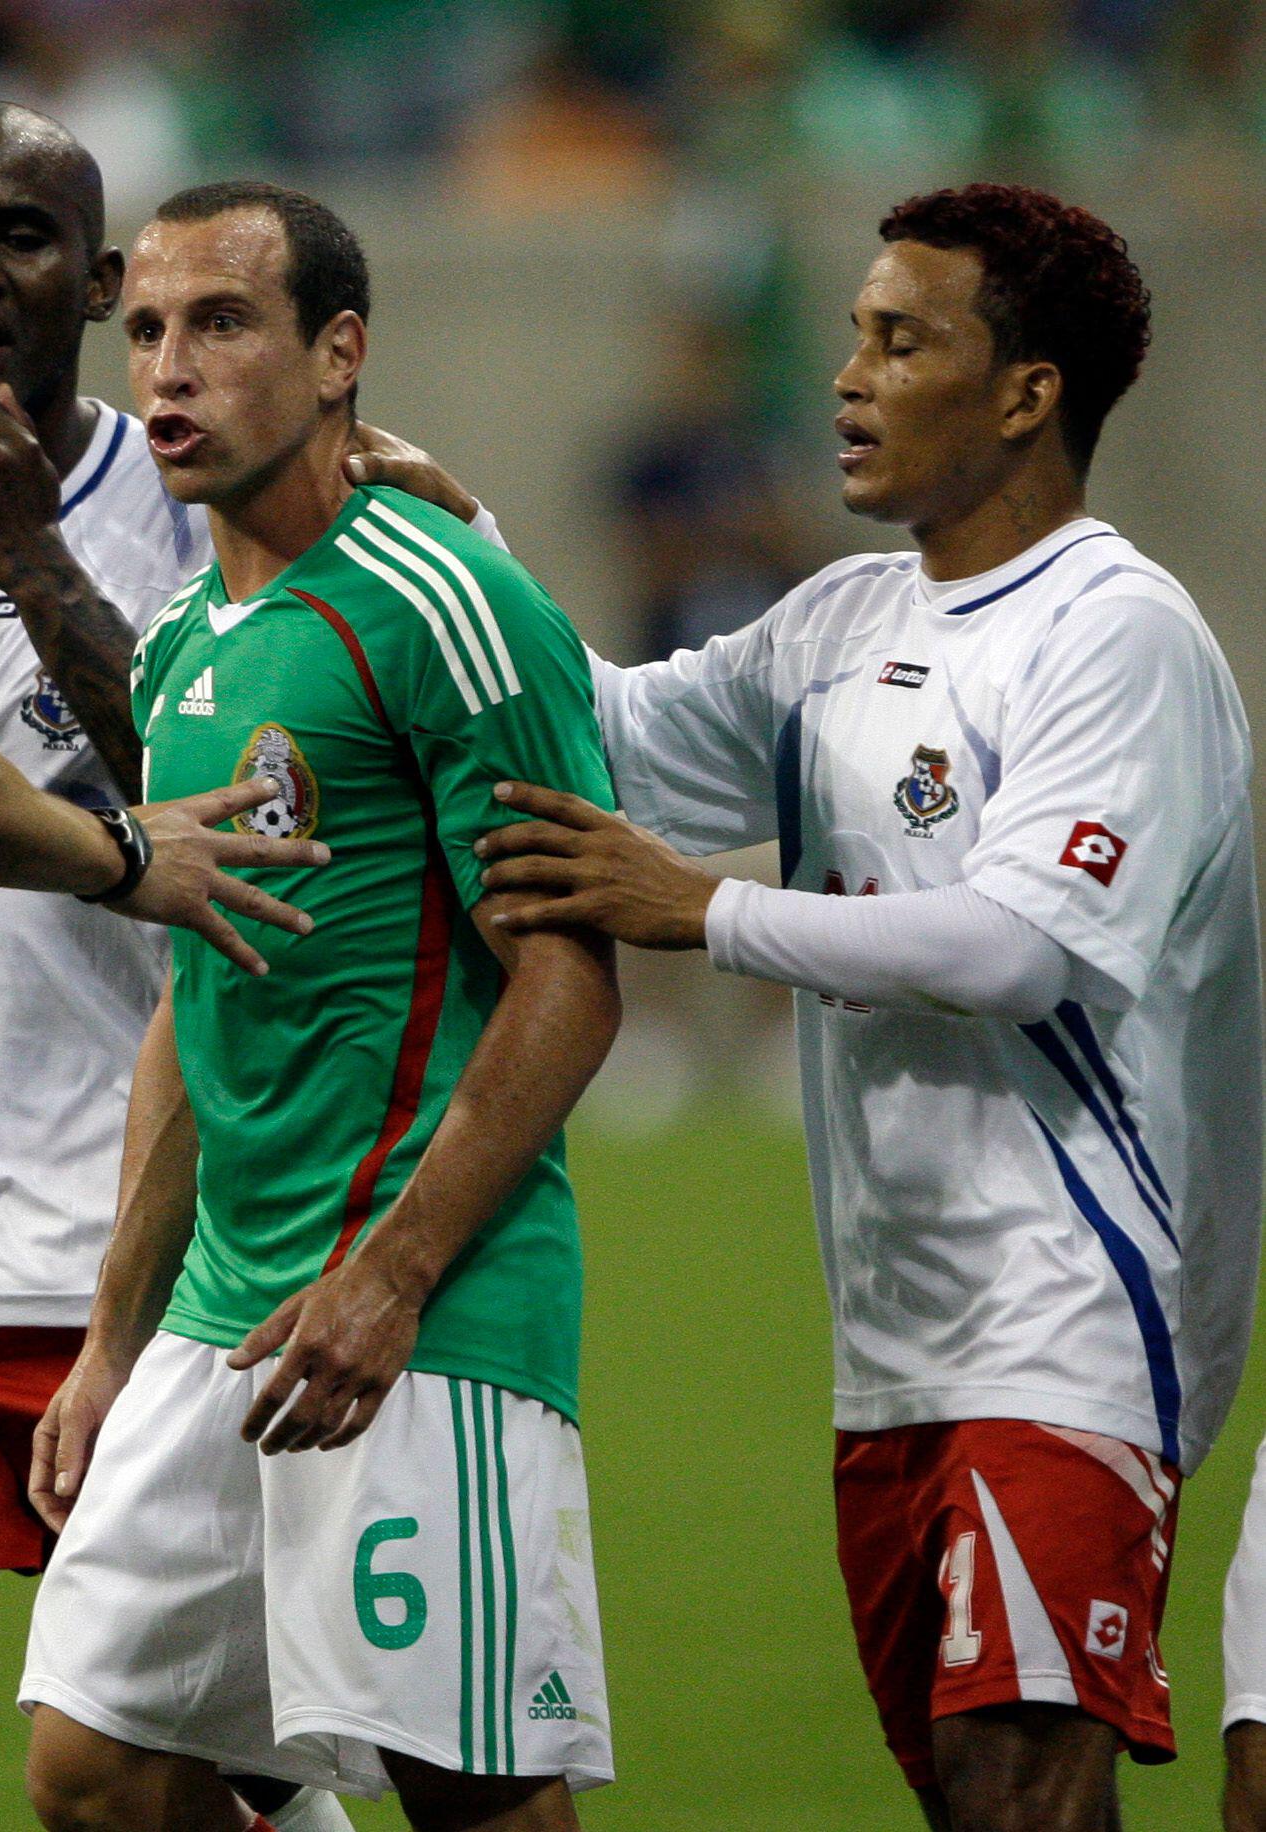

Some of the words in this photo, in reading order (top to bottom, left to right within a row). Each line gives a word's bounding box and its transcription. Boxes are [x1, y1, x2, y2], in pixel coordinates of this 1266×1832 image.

[178, 699, 215, 716] adidas
[353, 1516, 427, 1650] 6
[528, 1703, 577, 1720] adidas
